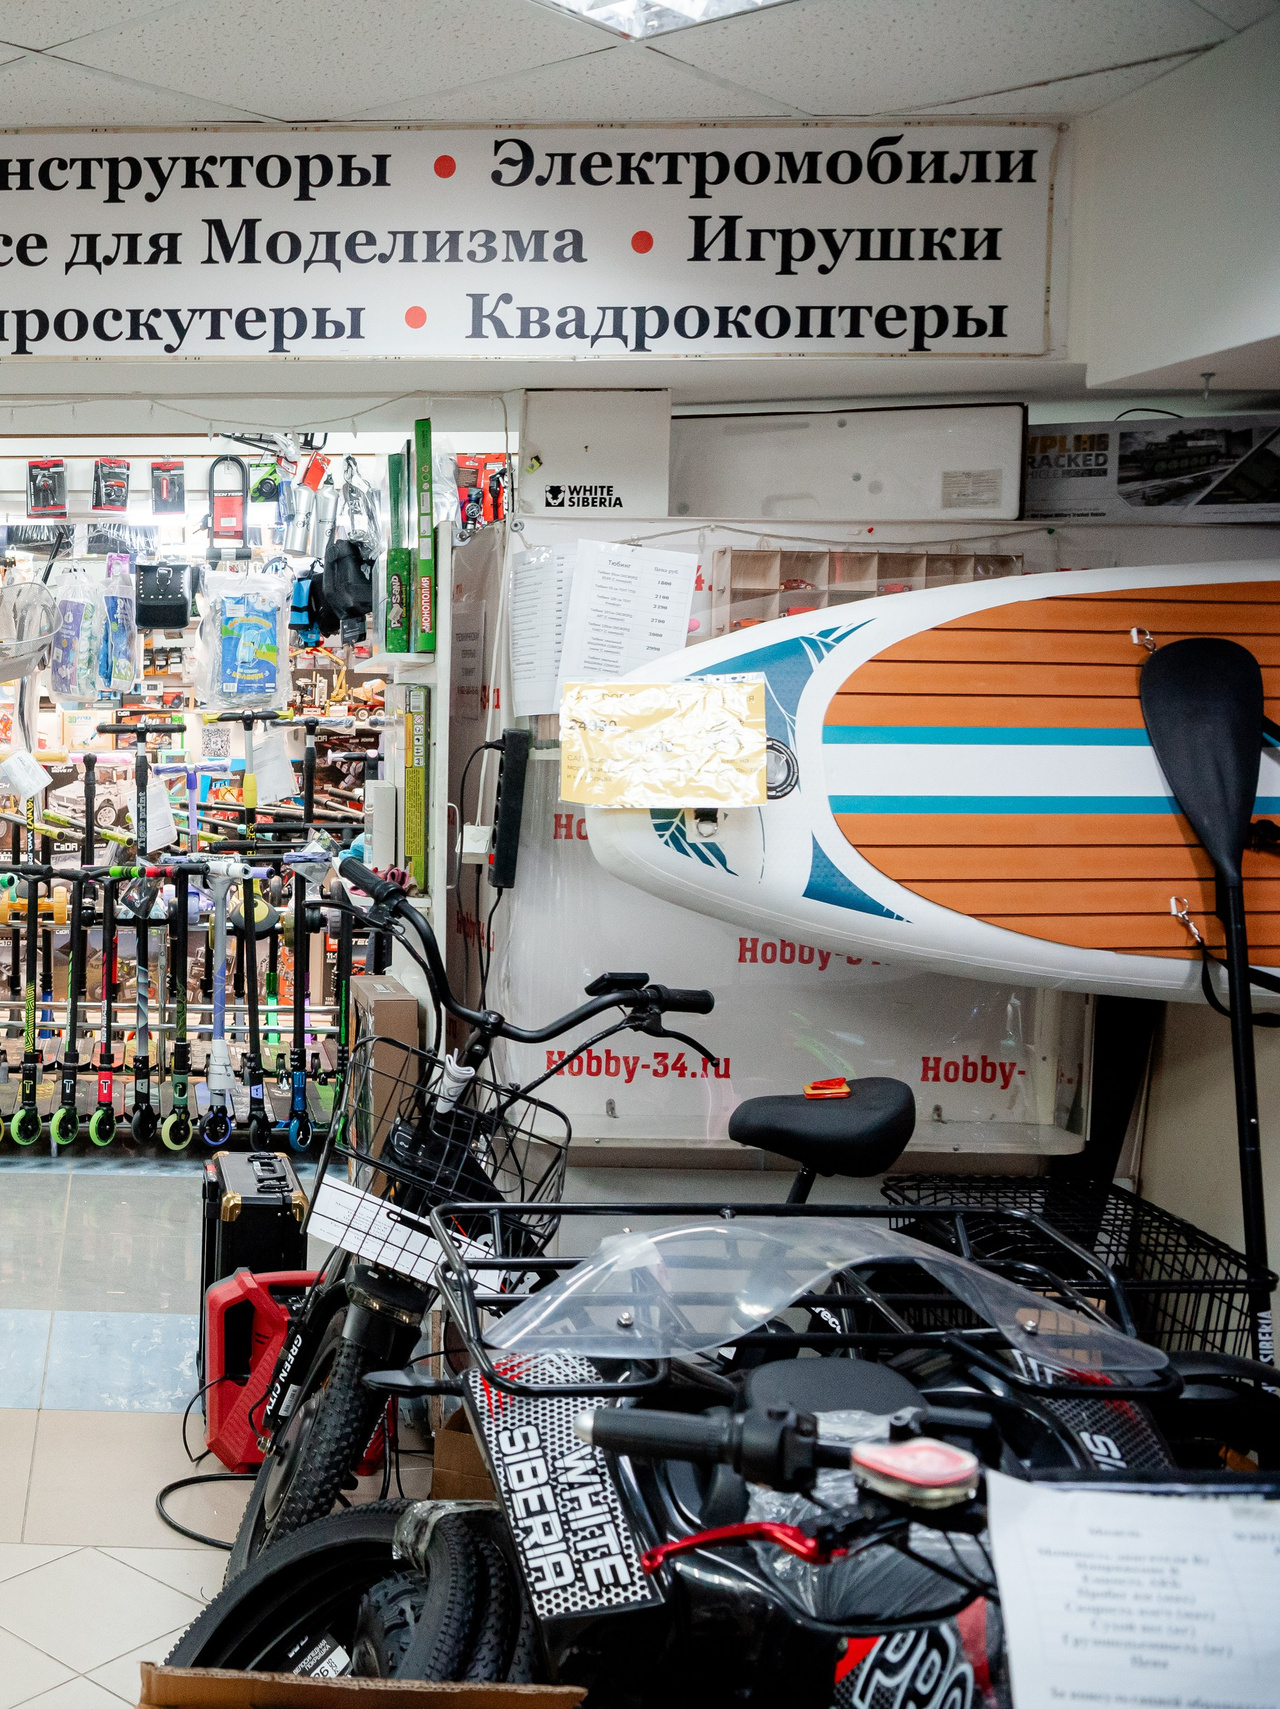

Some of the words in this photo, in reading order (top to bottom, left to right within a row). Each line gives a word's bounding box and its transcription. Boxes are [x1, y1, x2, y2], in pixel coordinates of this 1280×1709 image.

[491, 134, 1038, 199] Электромобили
[65, 232, 182, 274] для
[201, 217, 587, 274] Моделизма
[687, 215, 1003, 275] Игрушки
[465, 292, 1008, 352] Квадрокоптеры
[1027, 453, 1108, 470] RACKED
[568, 485, 614, 496] WHITE
[568, 497, 623, 508] SIBERIA
[54, 843, 78, 851] CaDA
[545, 1050, 731, 1084] Hobby-34.ru
[1257, 1310, 1275, 1363] SIBERIA
[278, 1334, 302, 1382] GREEN
[266, 1383, 282, 1415] CITY
[498, 1424, 576, 1592] SIBERIA
[554, 1445, 632, 1593] WHITE
[293, 1639, 327, 1676] ВЕЛОСИПЕДНАЯ
